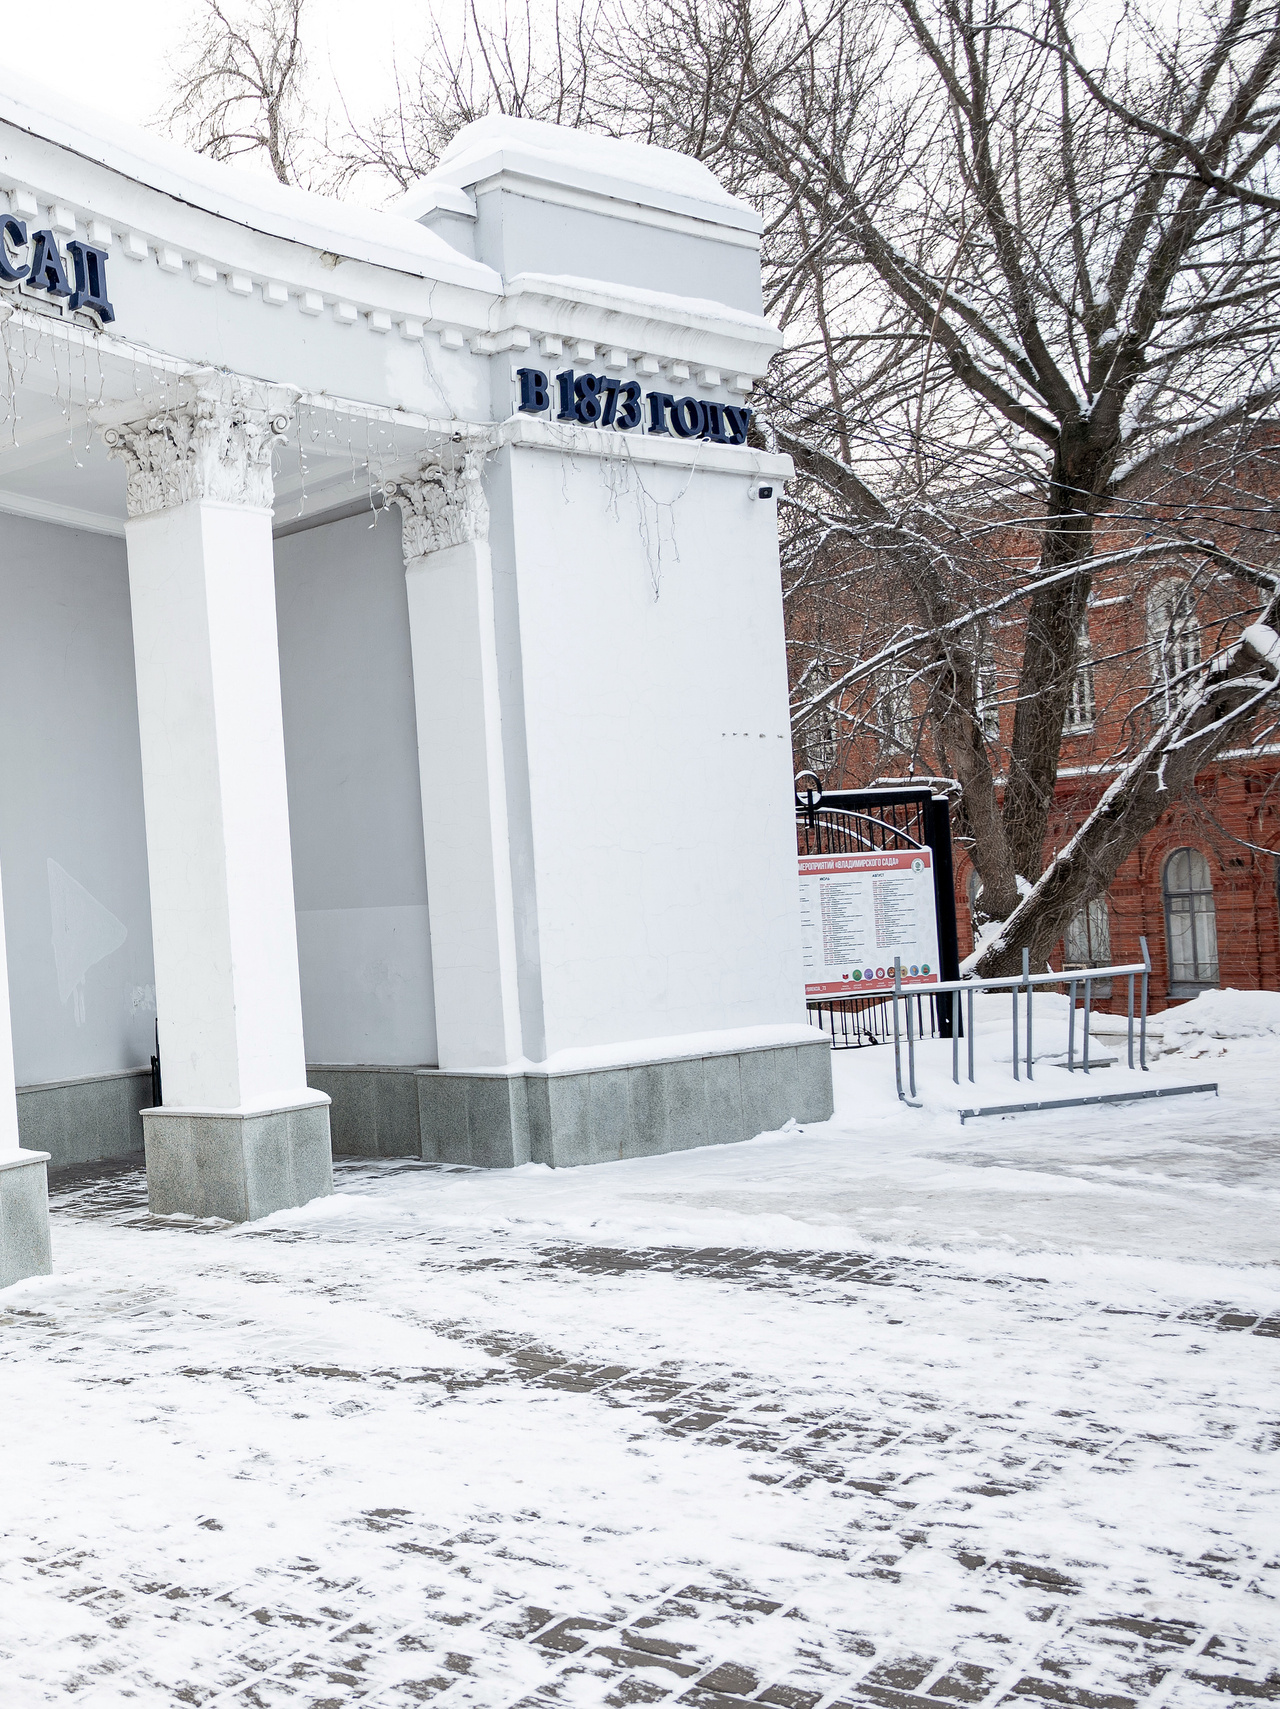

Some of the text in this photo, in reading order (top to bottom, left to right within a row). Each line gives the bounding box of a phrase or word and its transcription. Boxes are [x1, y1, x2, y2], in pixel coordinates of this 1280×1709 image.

[517, 367, 753, 445] В 1873 ГОДУ
